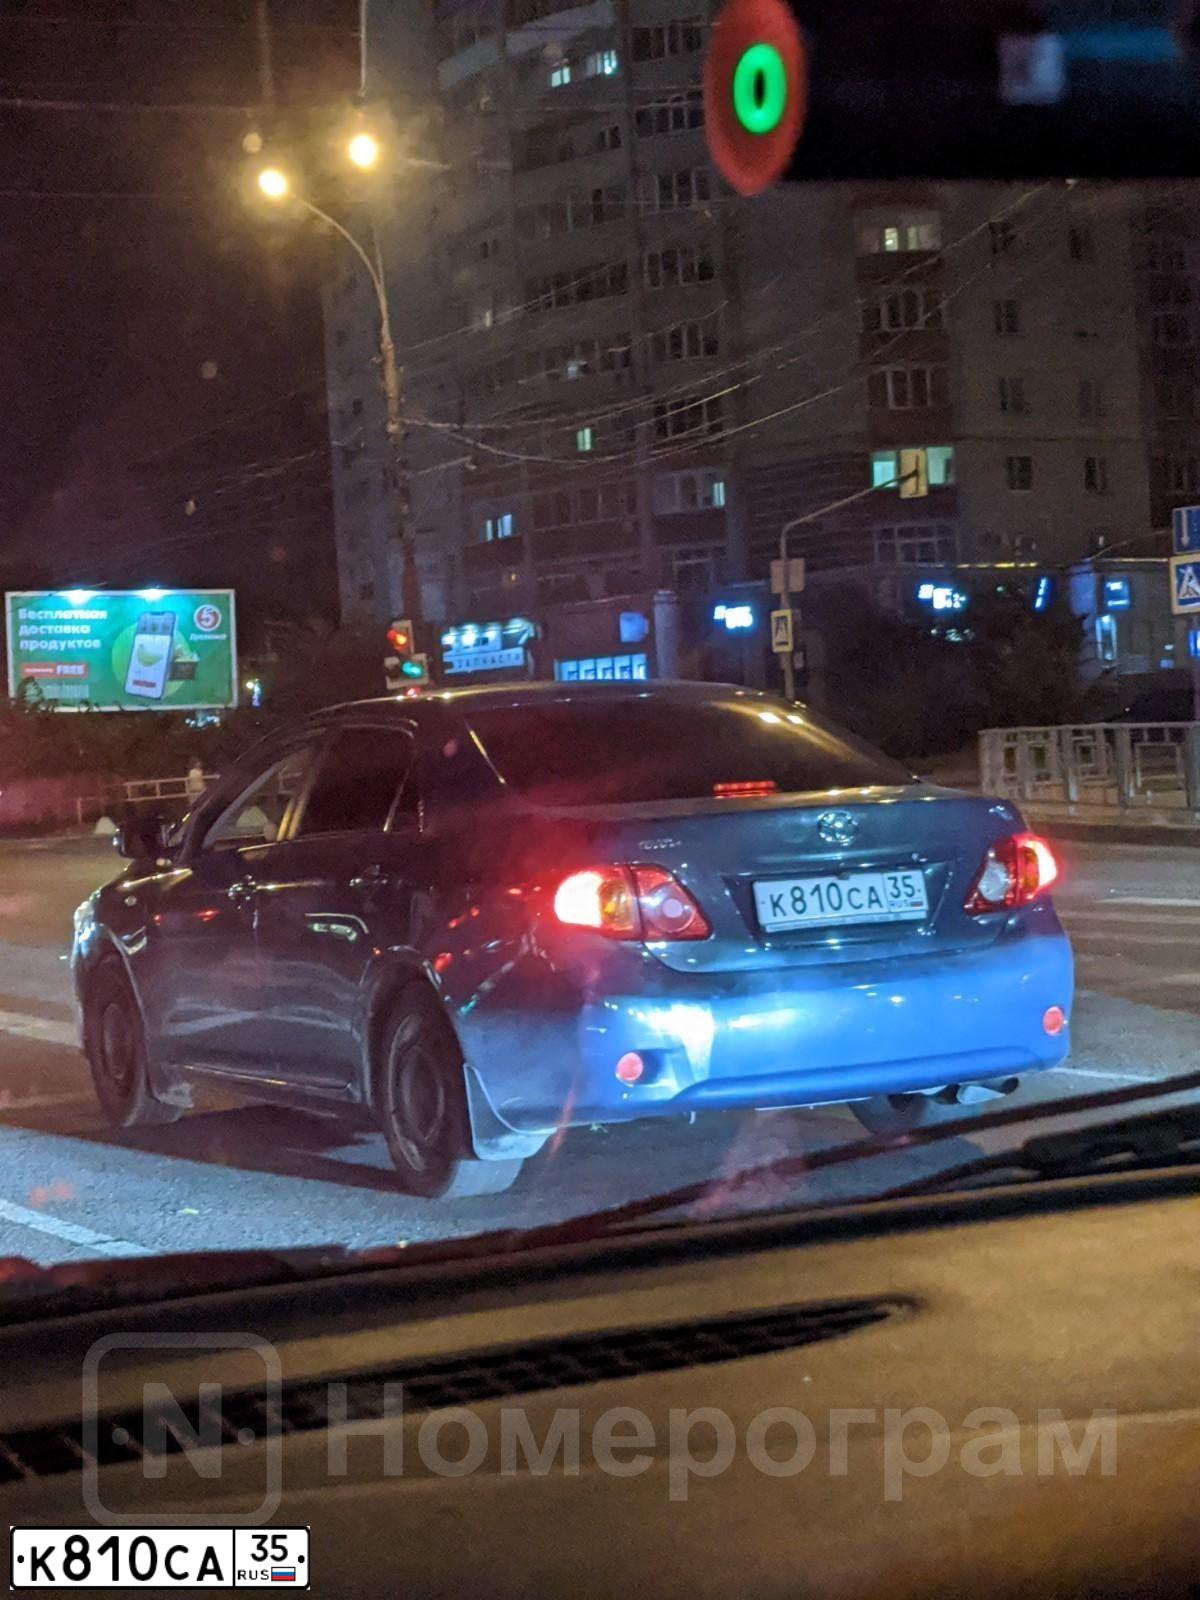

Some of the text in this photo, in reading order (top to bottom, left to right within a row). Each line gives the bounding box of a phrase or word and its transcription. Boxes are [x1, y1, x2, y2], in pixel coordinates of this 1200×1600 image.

[19, 639, 101, 652] продуктов
[769, 875, 915, 917] К810СА 35
